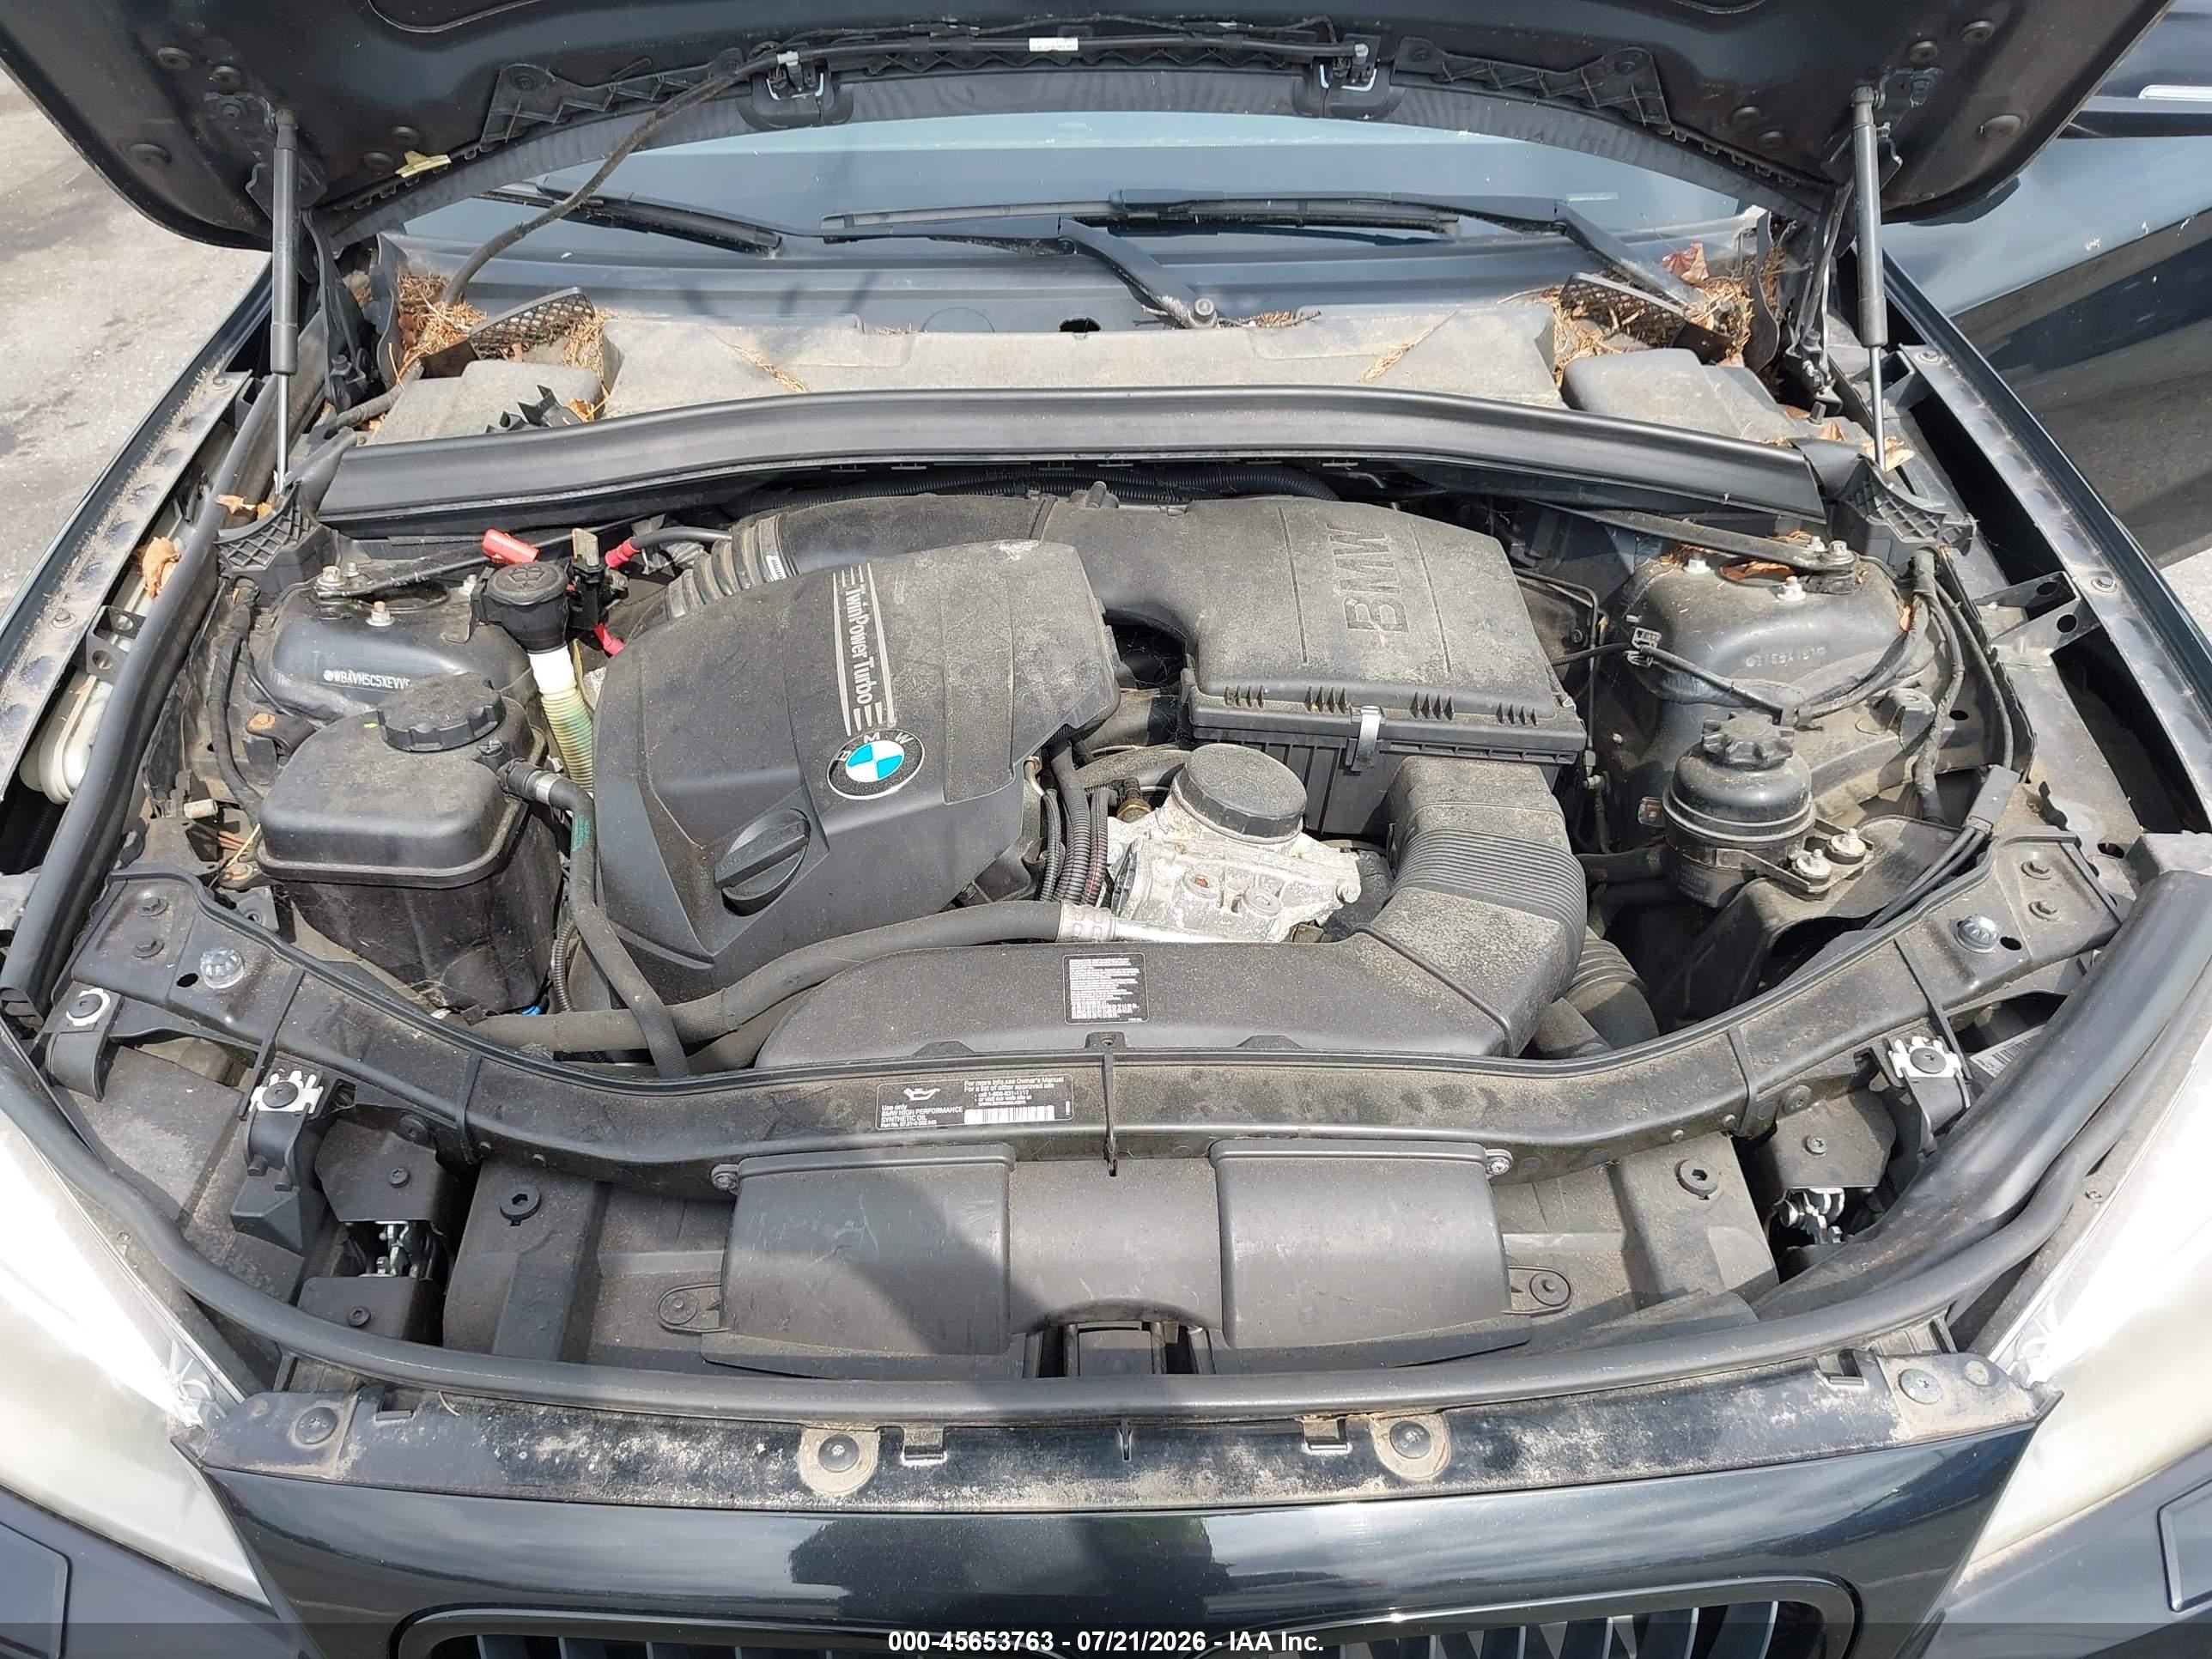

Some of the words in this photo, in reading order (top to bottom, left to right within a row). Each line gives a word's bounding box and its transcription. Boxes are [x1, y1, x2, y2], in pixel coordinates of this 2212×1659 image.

[1325, 523, 1410, 635] BMW
[845, 584, 869, 659] TwinPower
[853, 656, 878, 704] Turbo
[837, 732, 914, 762] BMW
[915, 1106, 963, 1115] PERFORMANCE
